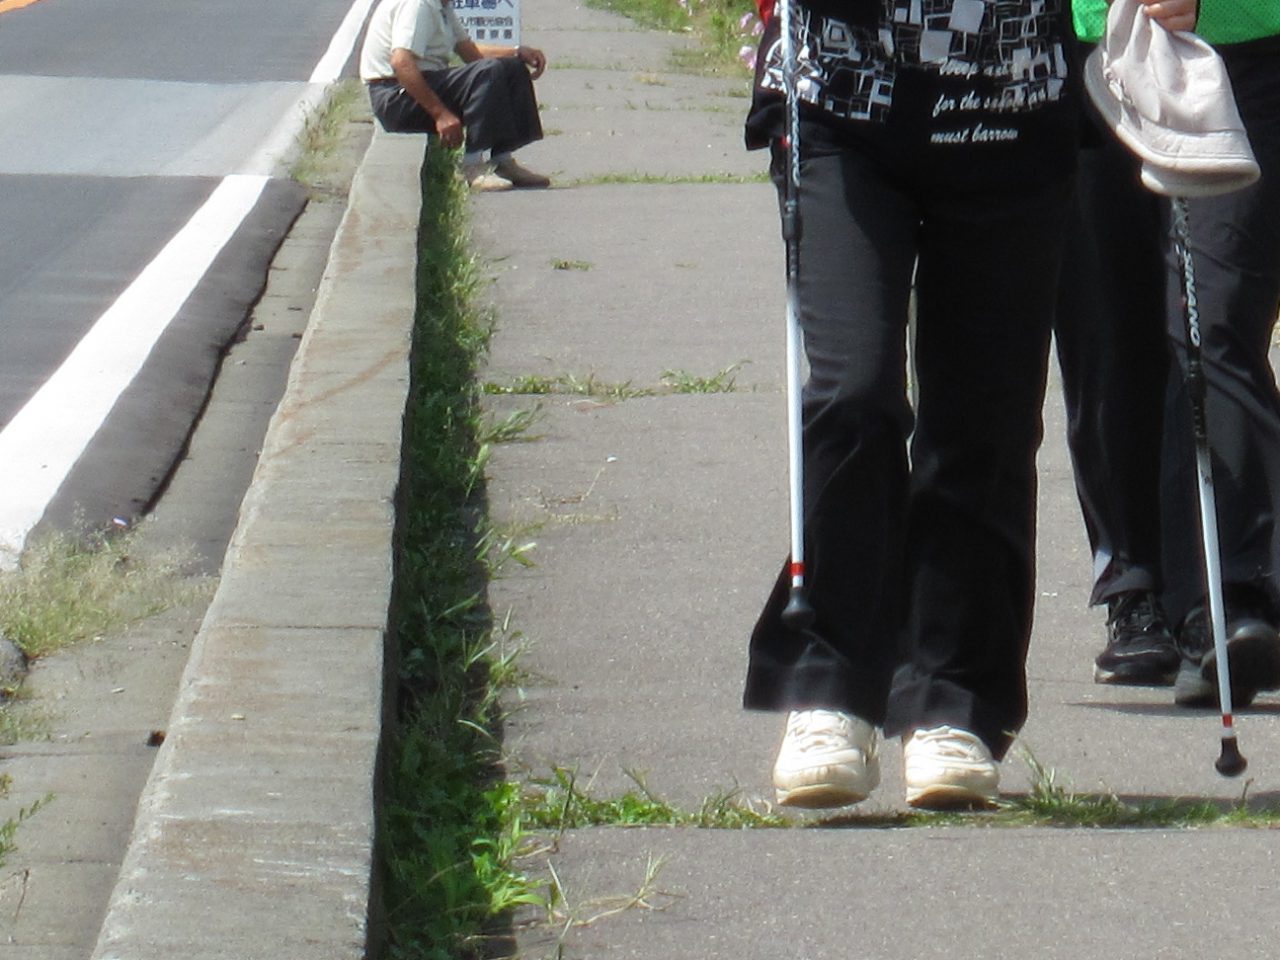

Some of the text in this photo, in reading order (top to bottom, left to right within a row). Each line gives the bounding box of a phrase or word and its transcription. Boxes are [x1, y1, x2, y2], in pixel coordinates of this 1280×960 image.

[932, 93, 957, 118] for
[959, 90, 981, 111] the
[930, 128, 969, 144] must
[1183, 249, 1201, 347] SINANO
